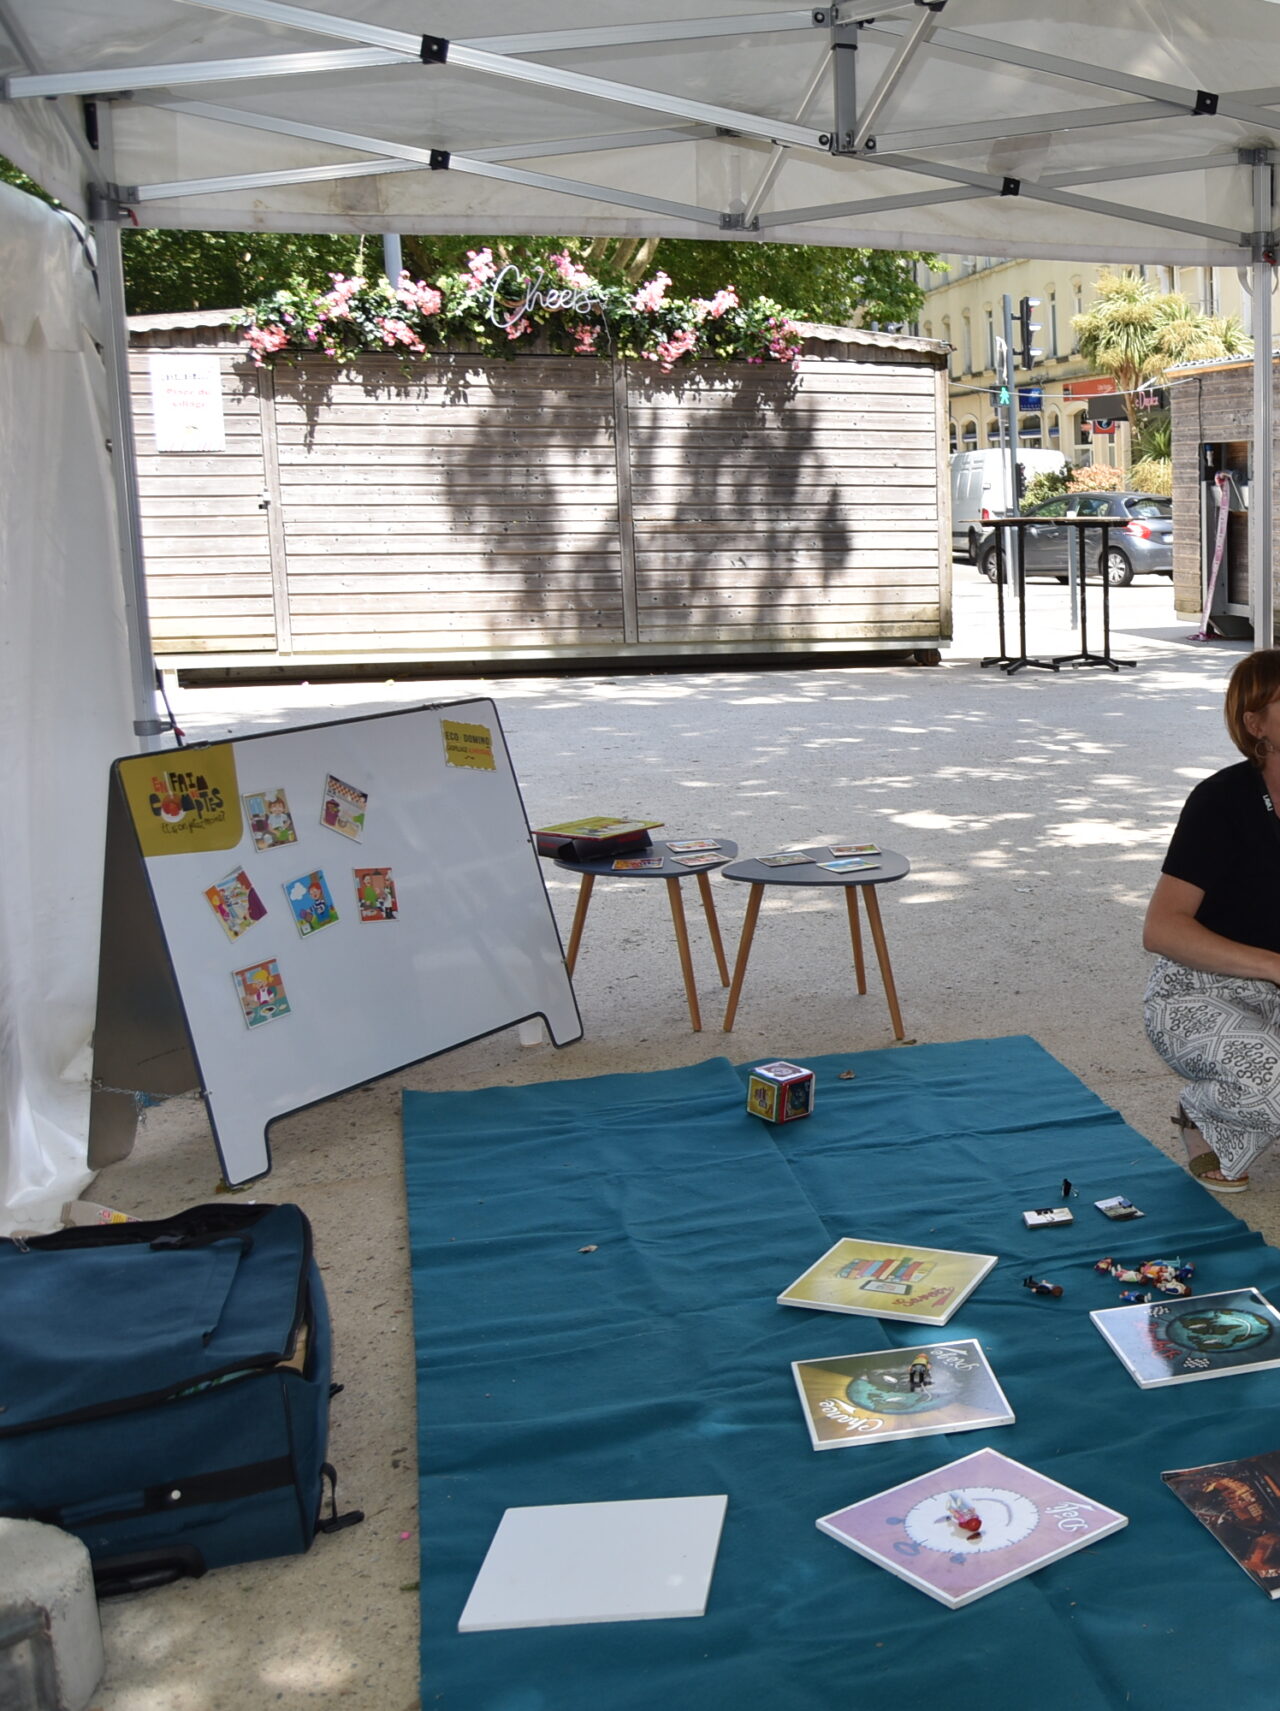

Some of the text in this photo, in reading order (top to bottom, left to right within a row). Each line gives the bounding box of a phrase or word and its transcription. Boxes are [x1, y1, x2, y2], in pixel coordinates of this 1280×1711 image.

[490, 264, 601, 328] Cheers
[819, 1398, 884, 1433] Chance
[1044, 1501, 1089, 1533] Défi
